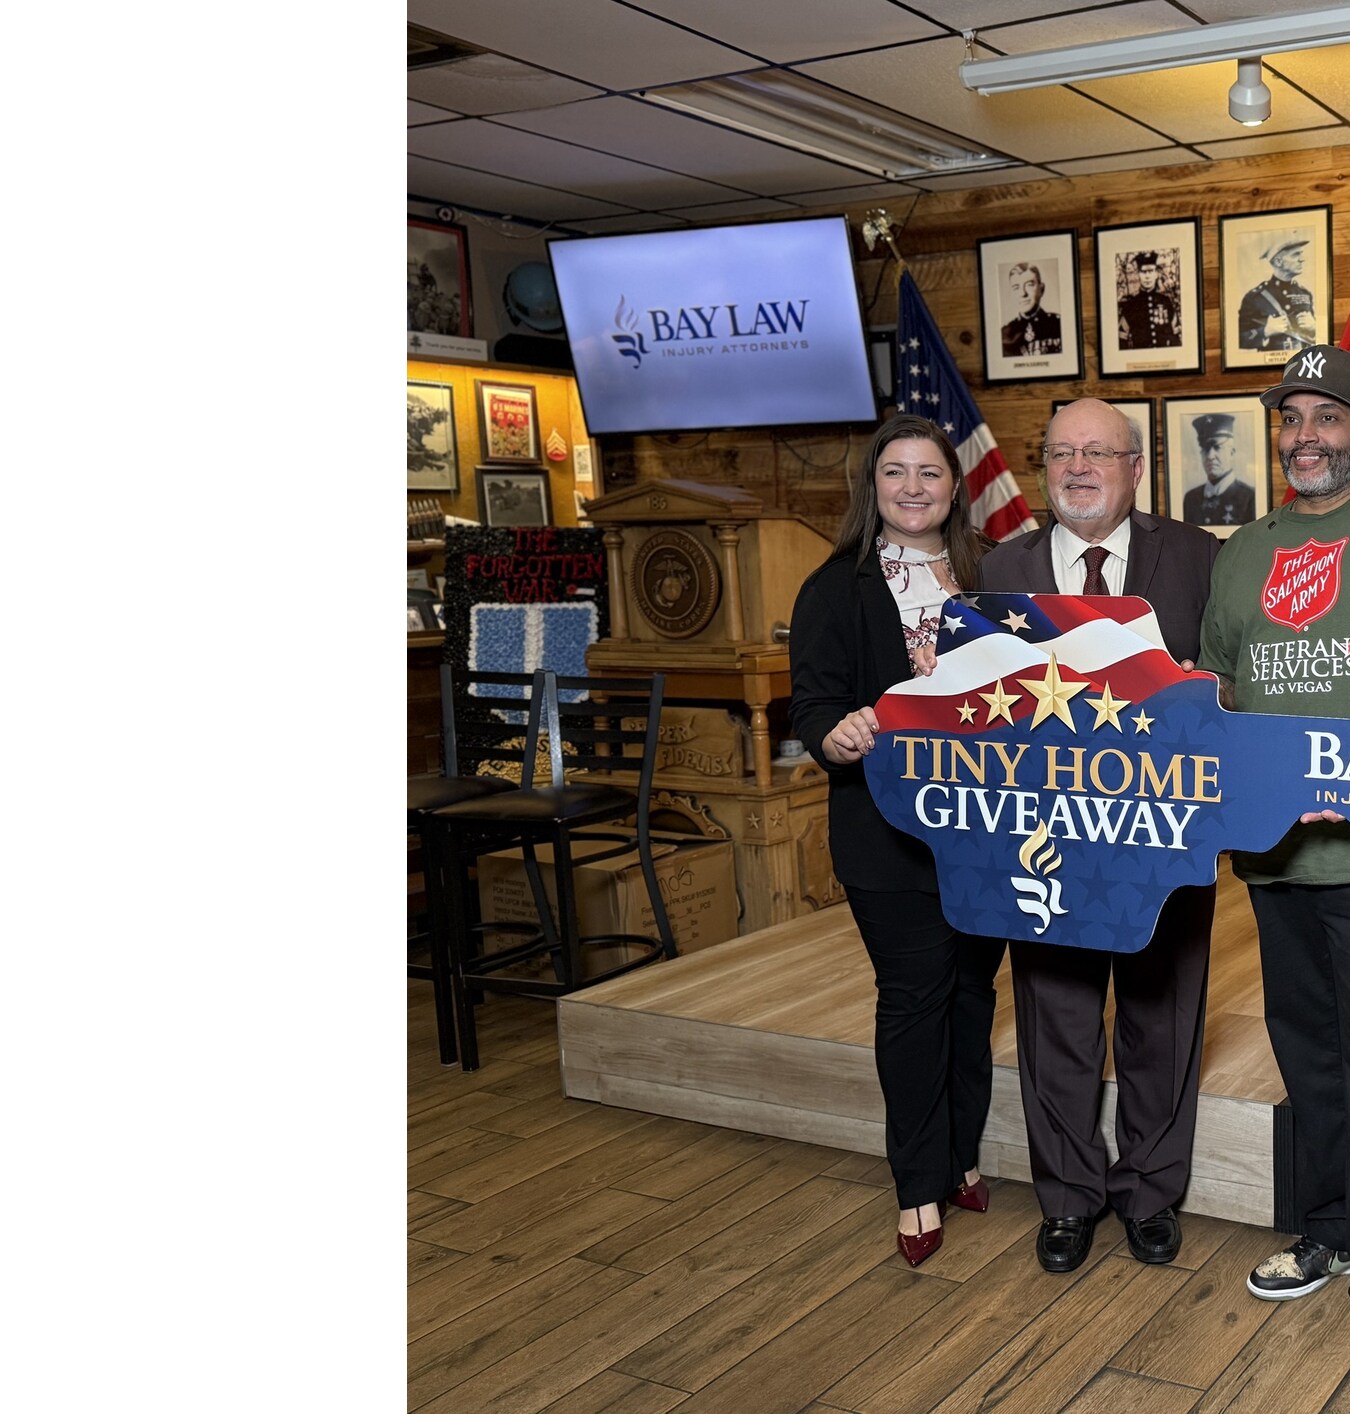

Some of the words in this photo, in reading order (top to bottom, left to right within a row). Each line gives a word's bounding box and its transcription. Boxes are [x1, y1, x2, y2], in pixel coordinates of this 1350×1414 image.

[647, 306, 720, 342] BAY
[724, 299, 810, 337] LAW
[662, 346, 714, 358] INJURY
[721, 340, 809, 354] ATTORNEYS
[1297, 351, 1327, 379] NY
[511, 528, 559, 552] THE
[638, 536, 664, 565] UNITED
[466, 553, 603, 579] FORGOTTEN
[1282, 549, 1314, 577] THE
[502, 578, 559, 603] WAR
[1266, 547, 1338, 609] SALVATION
[1289, 570, 1330, 619] ARMY
[640, 600, 672, 629] MARINE
[679, 602, 706, 629] CORPS
[1265, 683, 1284, 695] LAS
[1287, 681, 1332, 693] VEGAS
[893, 735, 1030, 787] TINY
[1043, 745, 1222, 803] HOME
[914, 783, 1200, 850] GIVEAWAY
